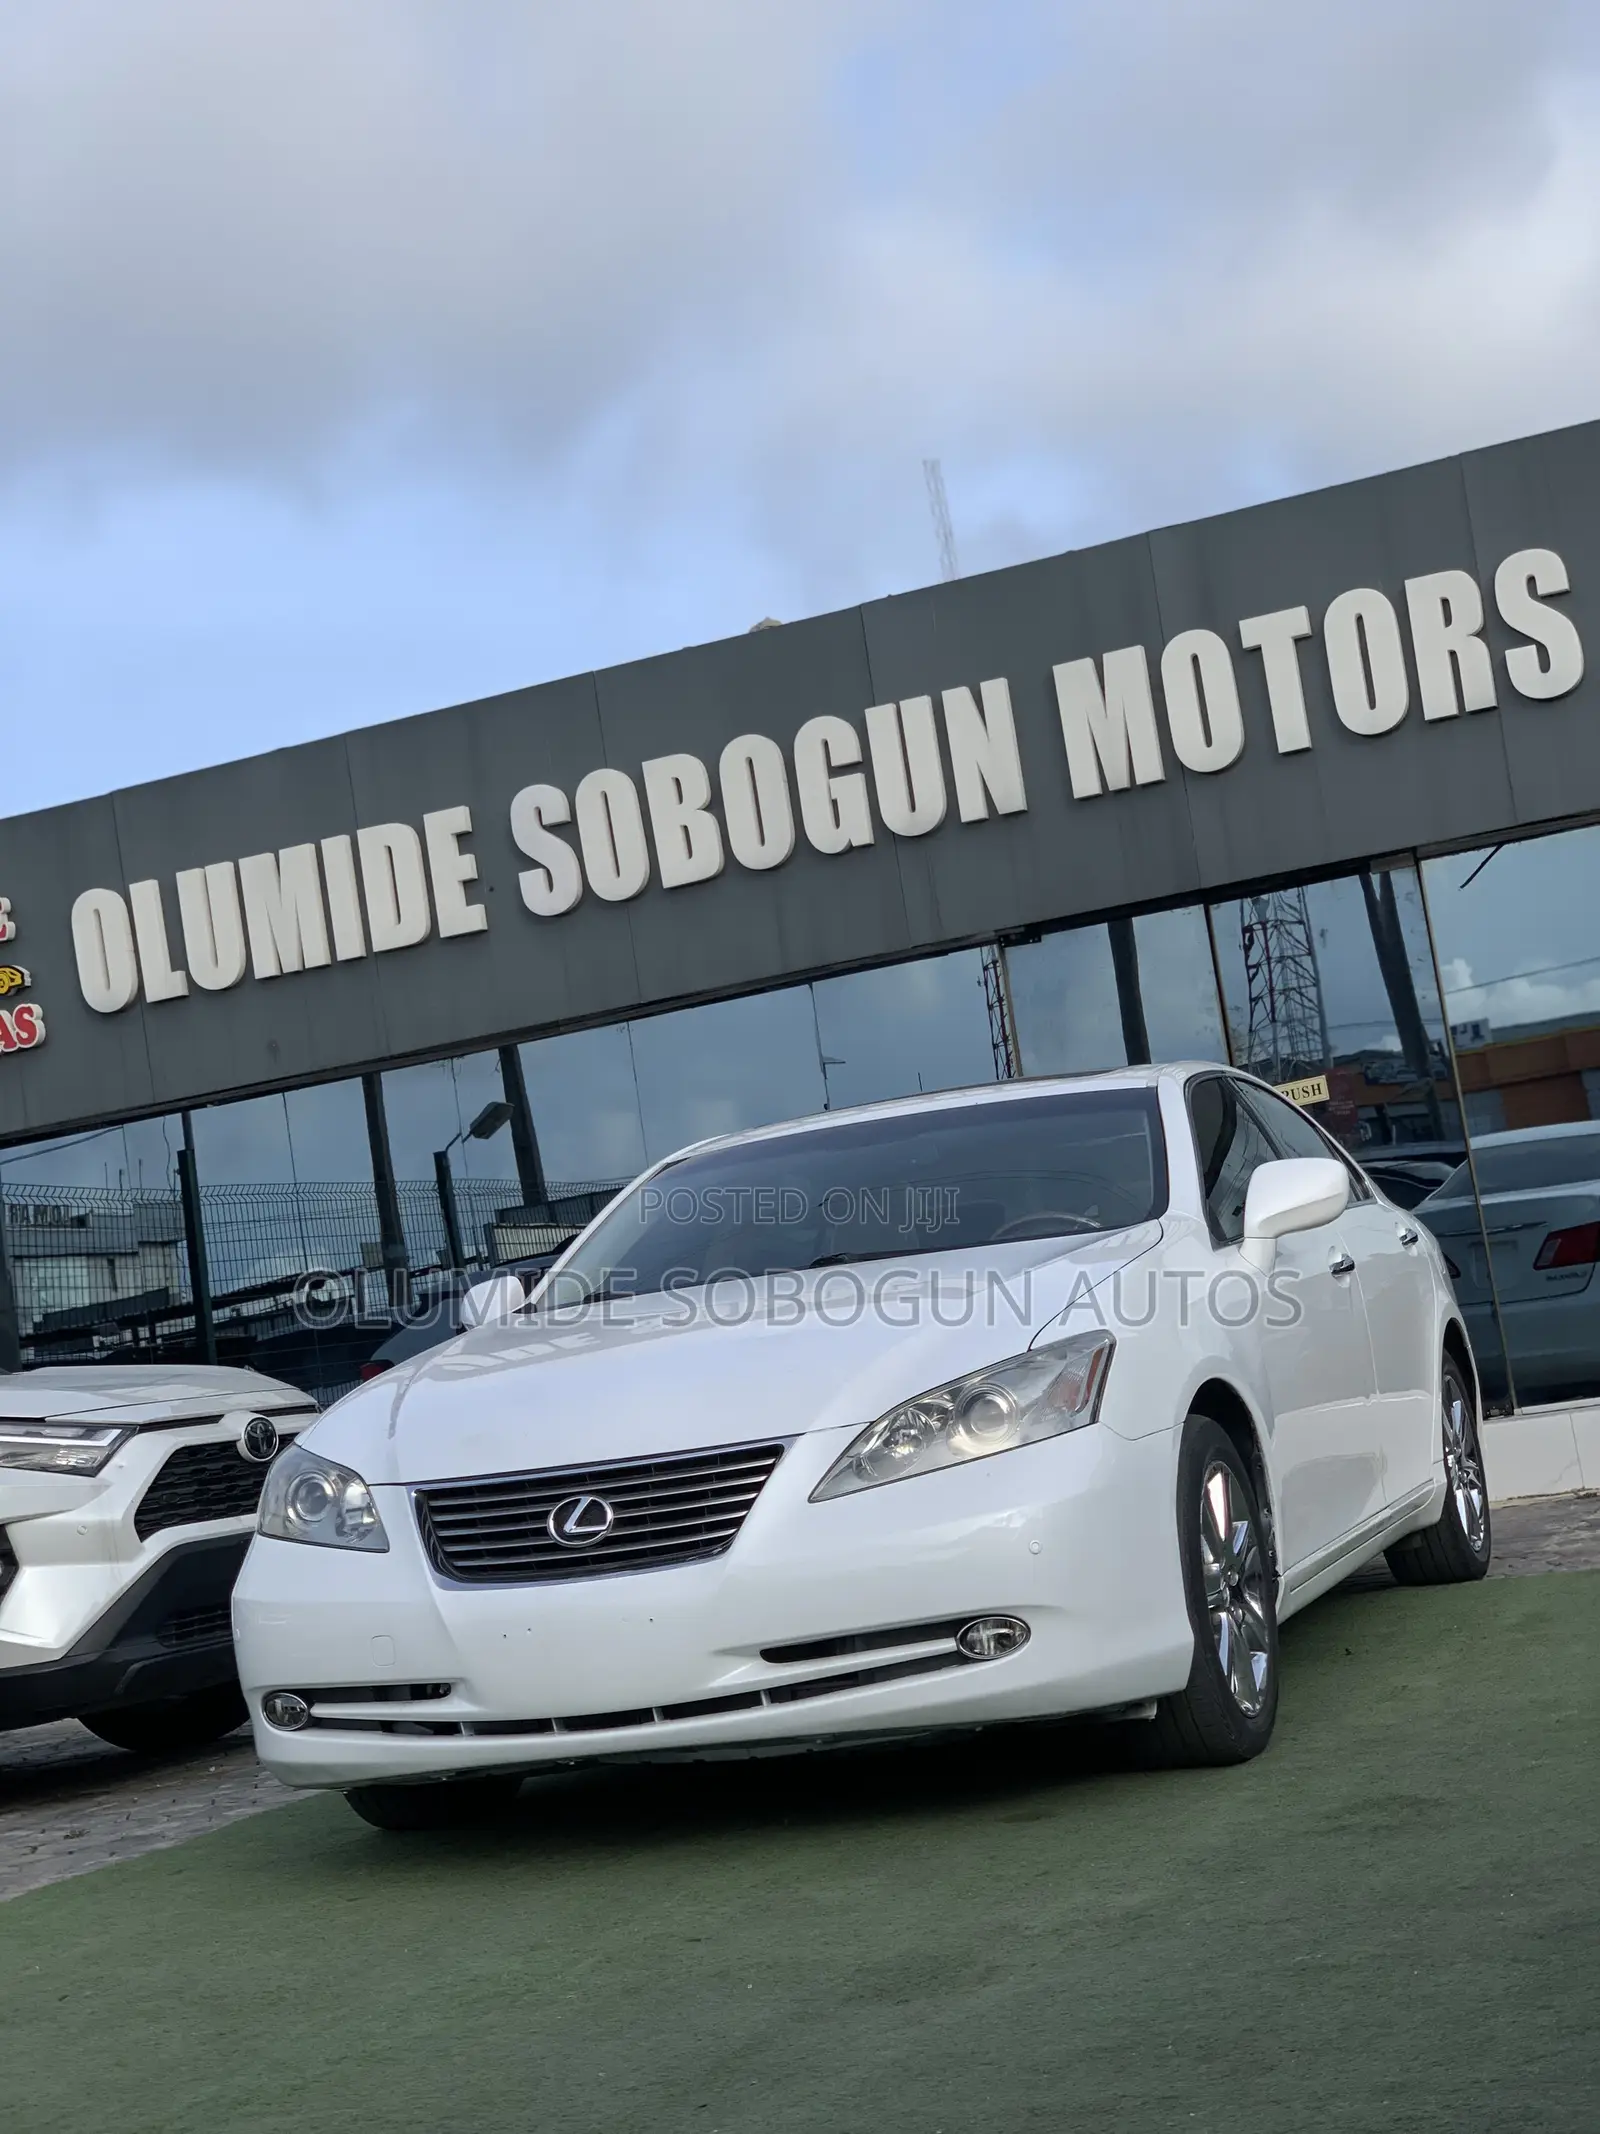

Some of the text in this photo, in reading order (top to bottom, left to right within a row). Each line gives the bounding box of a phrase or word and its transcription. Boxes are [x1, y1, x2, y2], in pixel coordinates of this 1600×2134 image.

[71, 547, 1584, 1014] OLUMIDE SOBOGUN MOTORS
